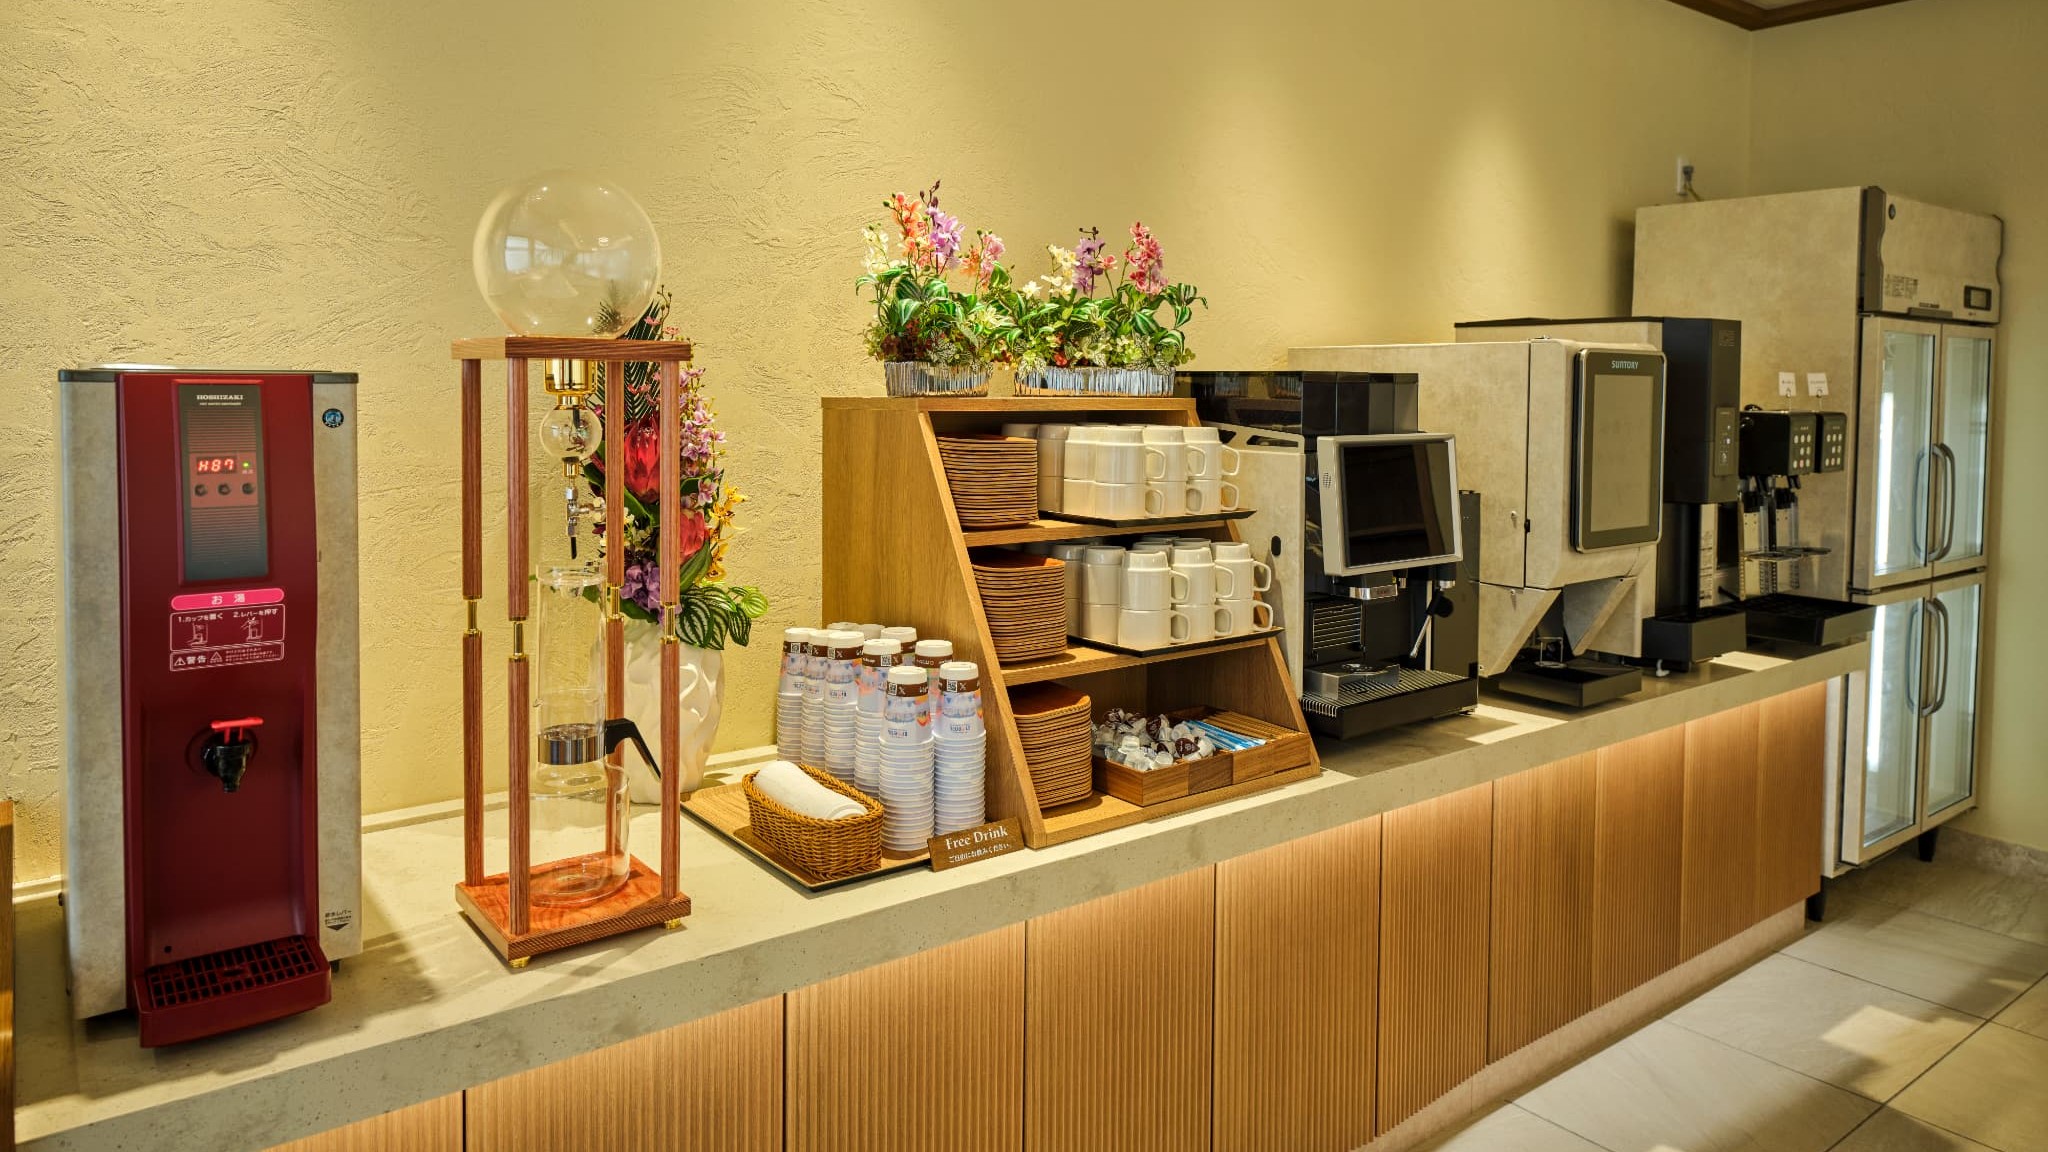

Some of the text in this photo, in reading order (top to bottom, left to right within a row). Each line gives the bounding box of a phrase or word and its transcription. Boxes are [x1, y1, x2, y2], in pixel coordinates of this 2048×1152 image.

[1611, 360, 1639, 369] SUNTORY
[197, 458, 235, 472] H87
[945, 825, 1008, 850] Free Drink
